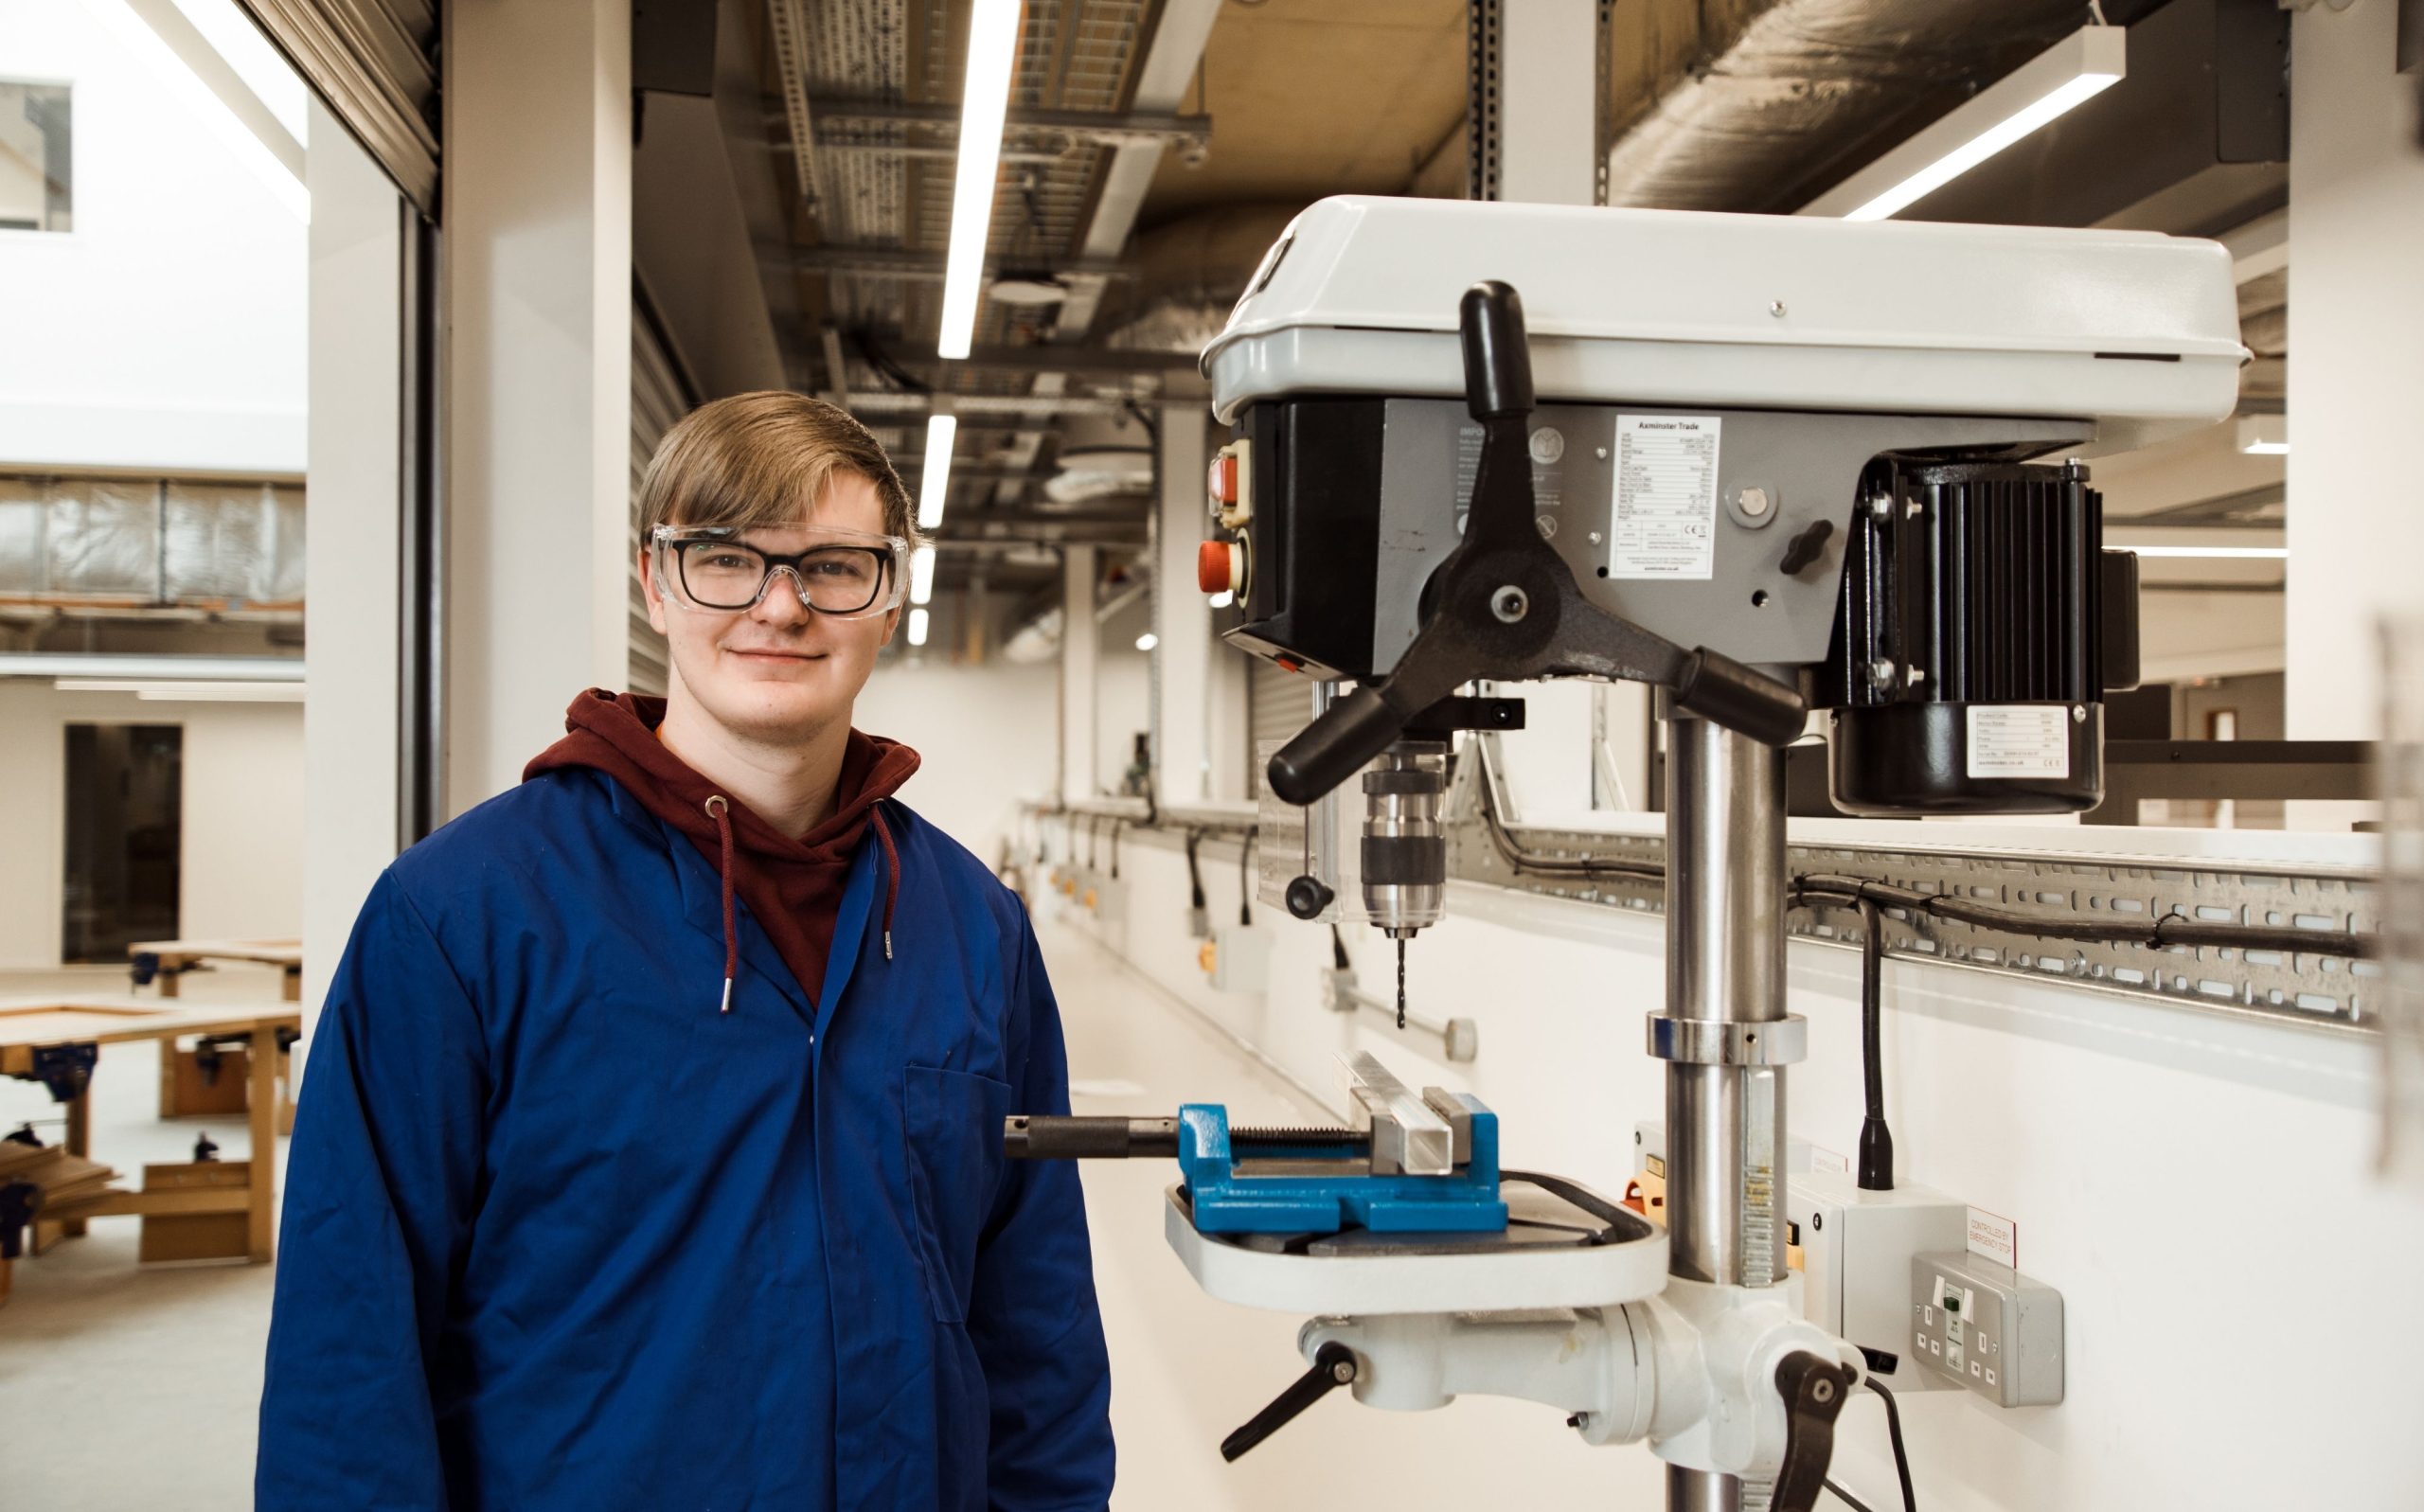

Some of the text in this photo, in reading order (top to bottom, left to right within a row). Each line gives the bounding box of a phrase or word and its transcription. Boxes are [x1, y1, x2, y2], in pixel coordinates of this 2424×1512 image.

[1638, 421, 1700, 430] Axminster Trade
[1970, 1218, 2008, 1241] CONTROLLED BY
[1969, 1230, 2012, 1254] EMERGENCY STOP
